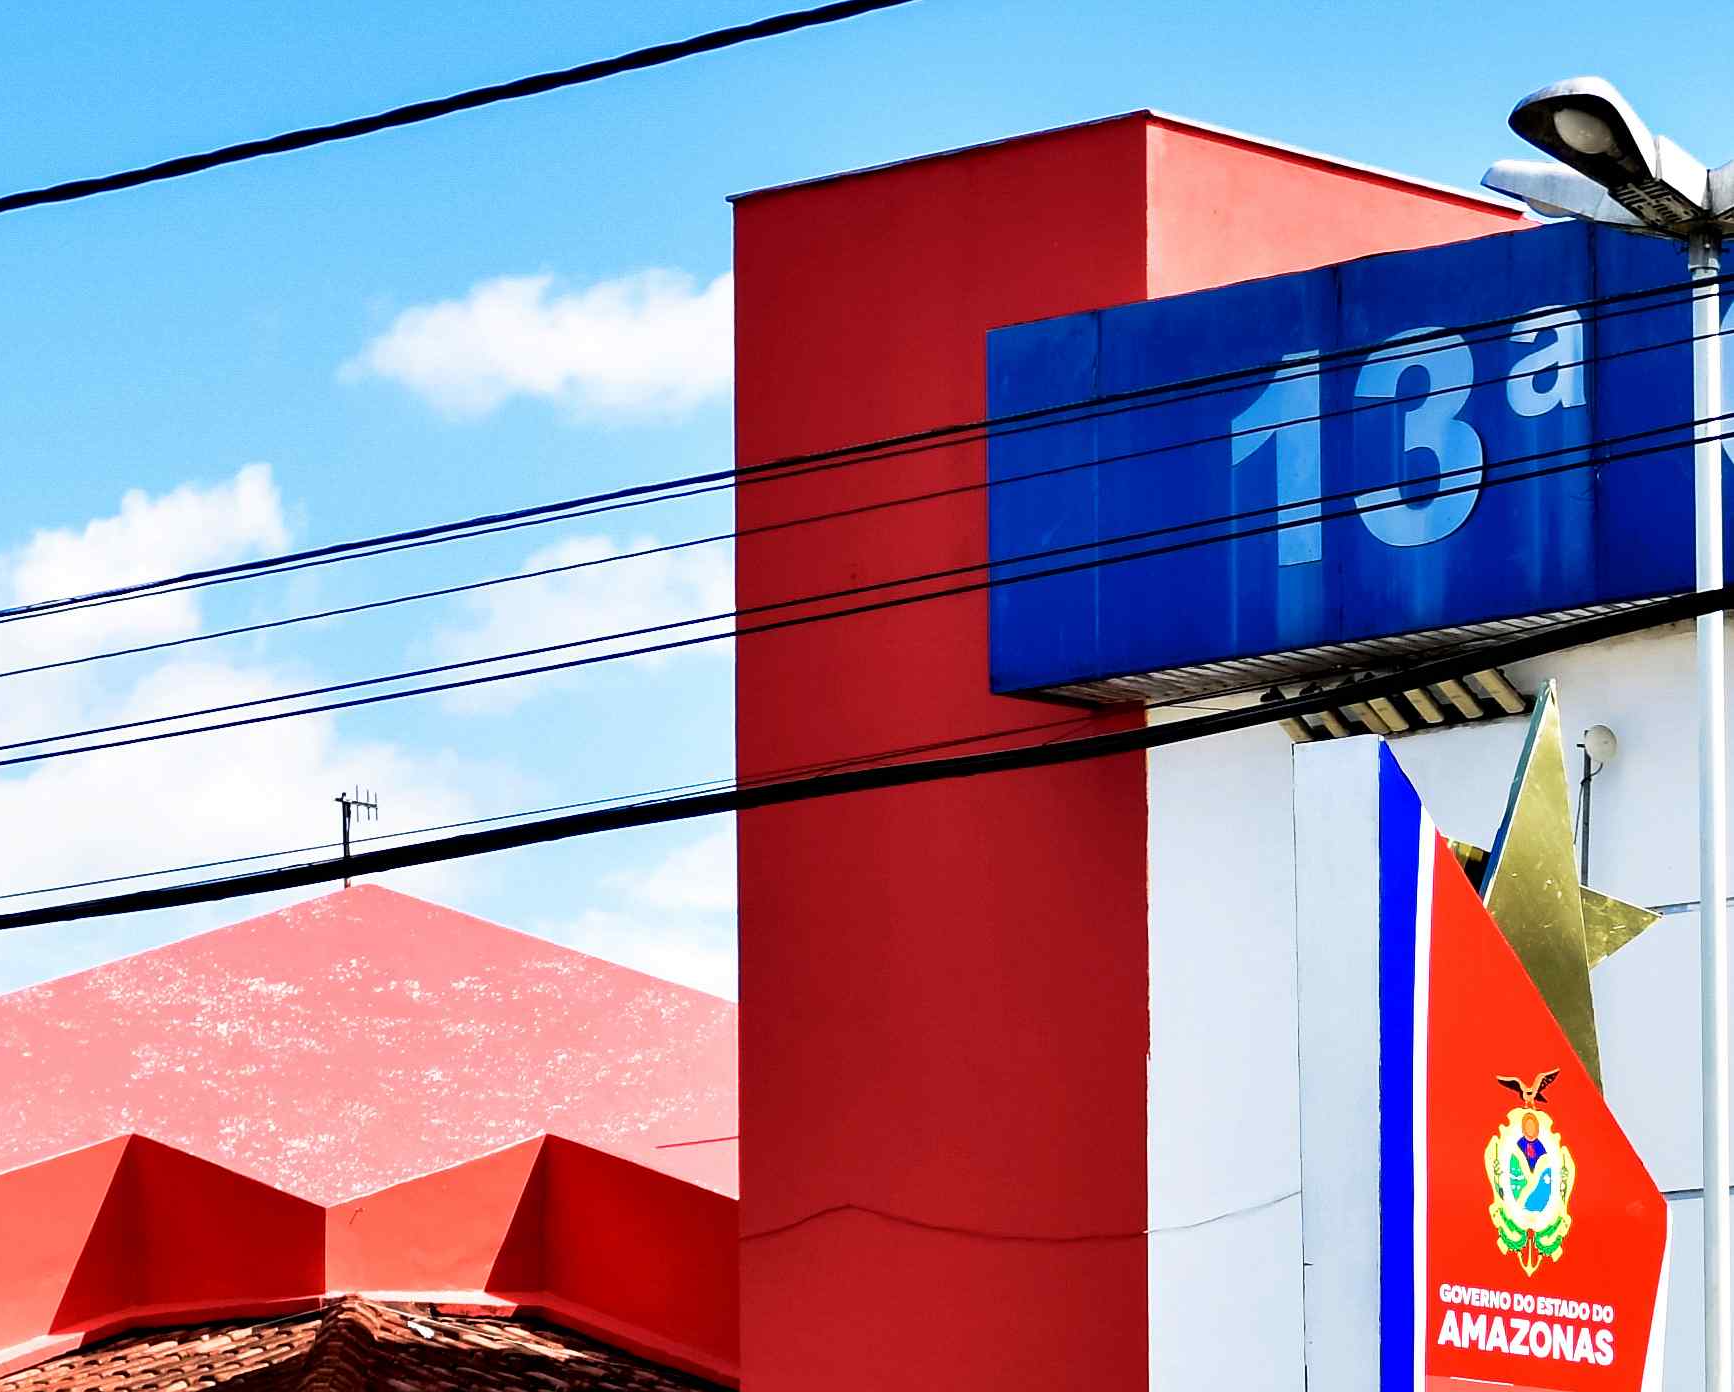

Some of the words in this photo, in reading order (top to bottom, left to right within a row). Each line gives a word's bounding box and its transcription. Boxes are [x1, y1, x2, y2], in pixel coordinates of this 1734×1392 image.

[1439, 1283, 1511, 1312] GOVERNO
[1513, 1293, 1535, 1314] DO
[1536, 1295, 1591, 1320] ESTADO
[1592, 1303, 1614, 1324] DO
[1437, 1310, 1614, 1366] AMAZONAS
